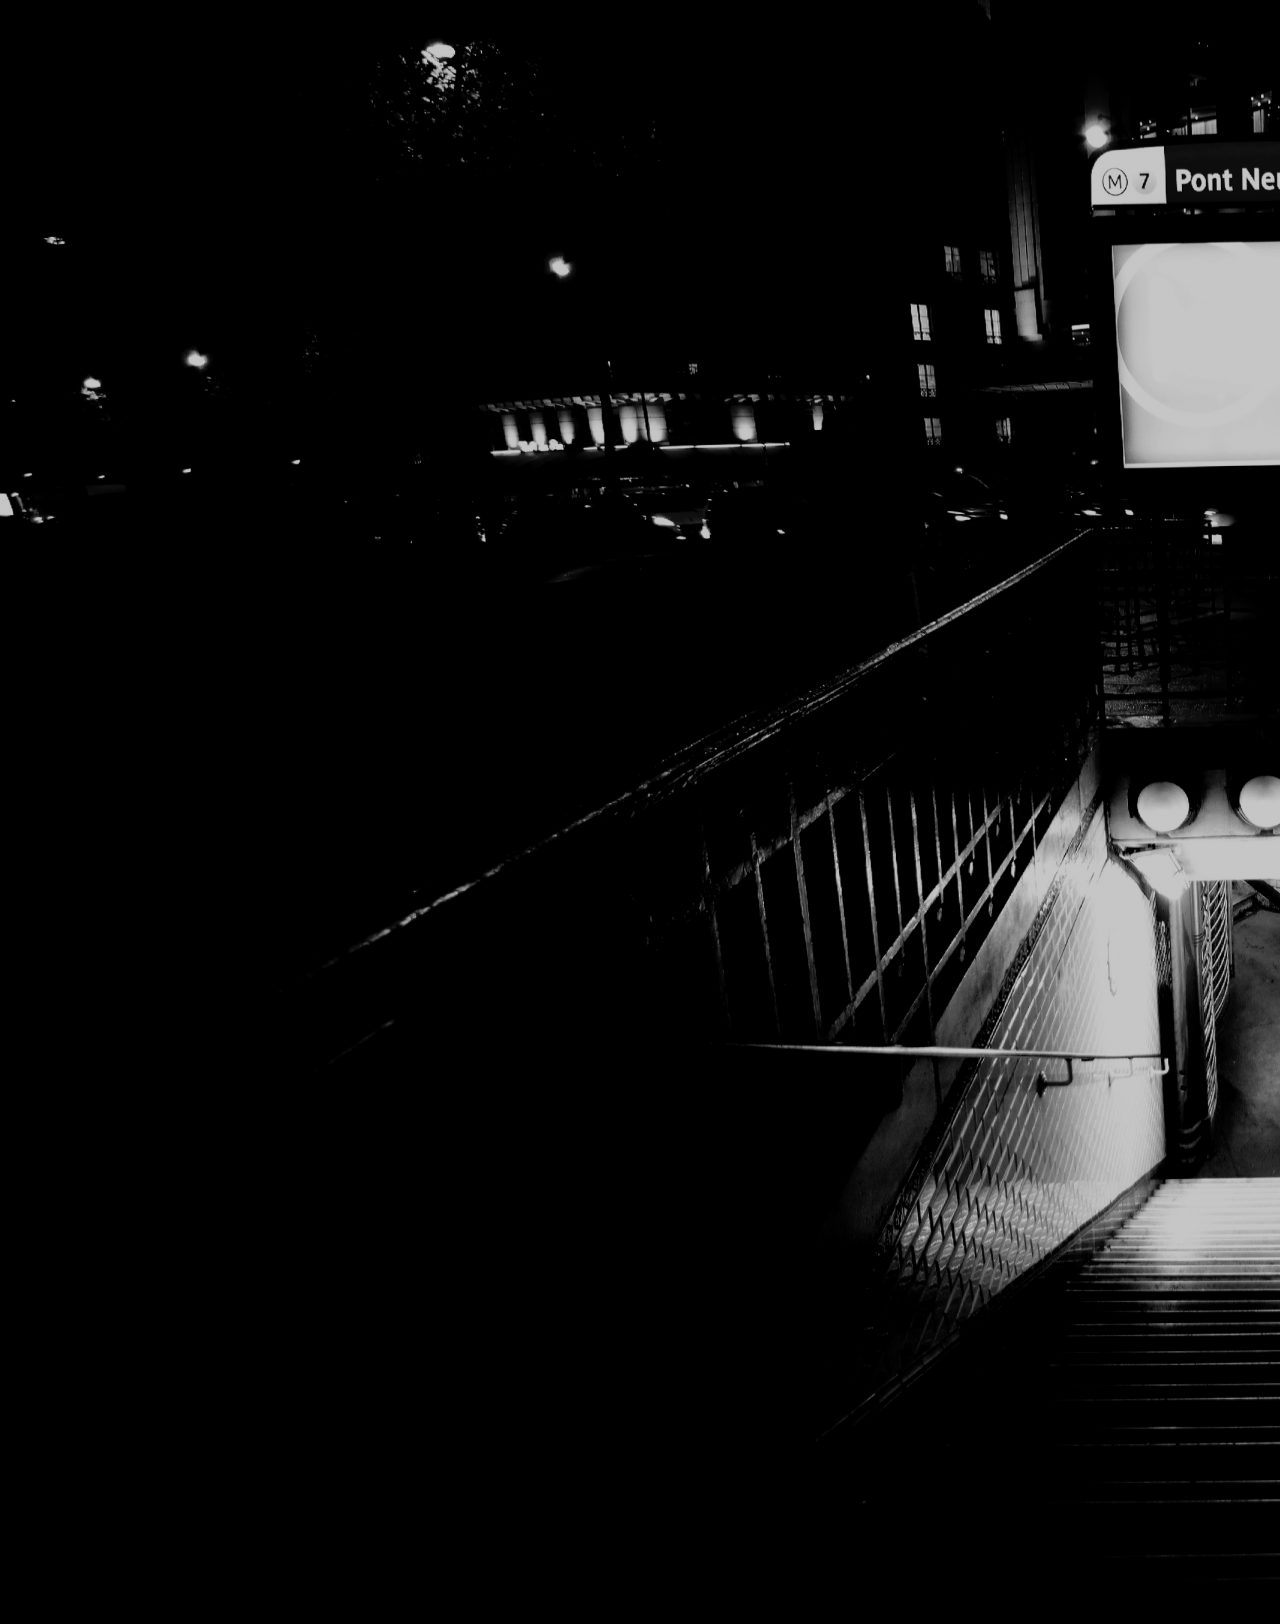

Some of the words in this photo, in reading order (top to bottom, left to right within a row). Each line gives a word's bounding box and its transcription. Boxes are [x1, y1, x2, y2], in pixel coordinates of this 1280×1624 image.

[1107, 173, 1122, 190] M
[1139, 172, 1150, 190] 7
[1175, 168, 1234, 192] Pont
